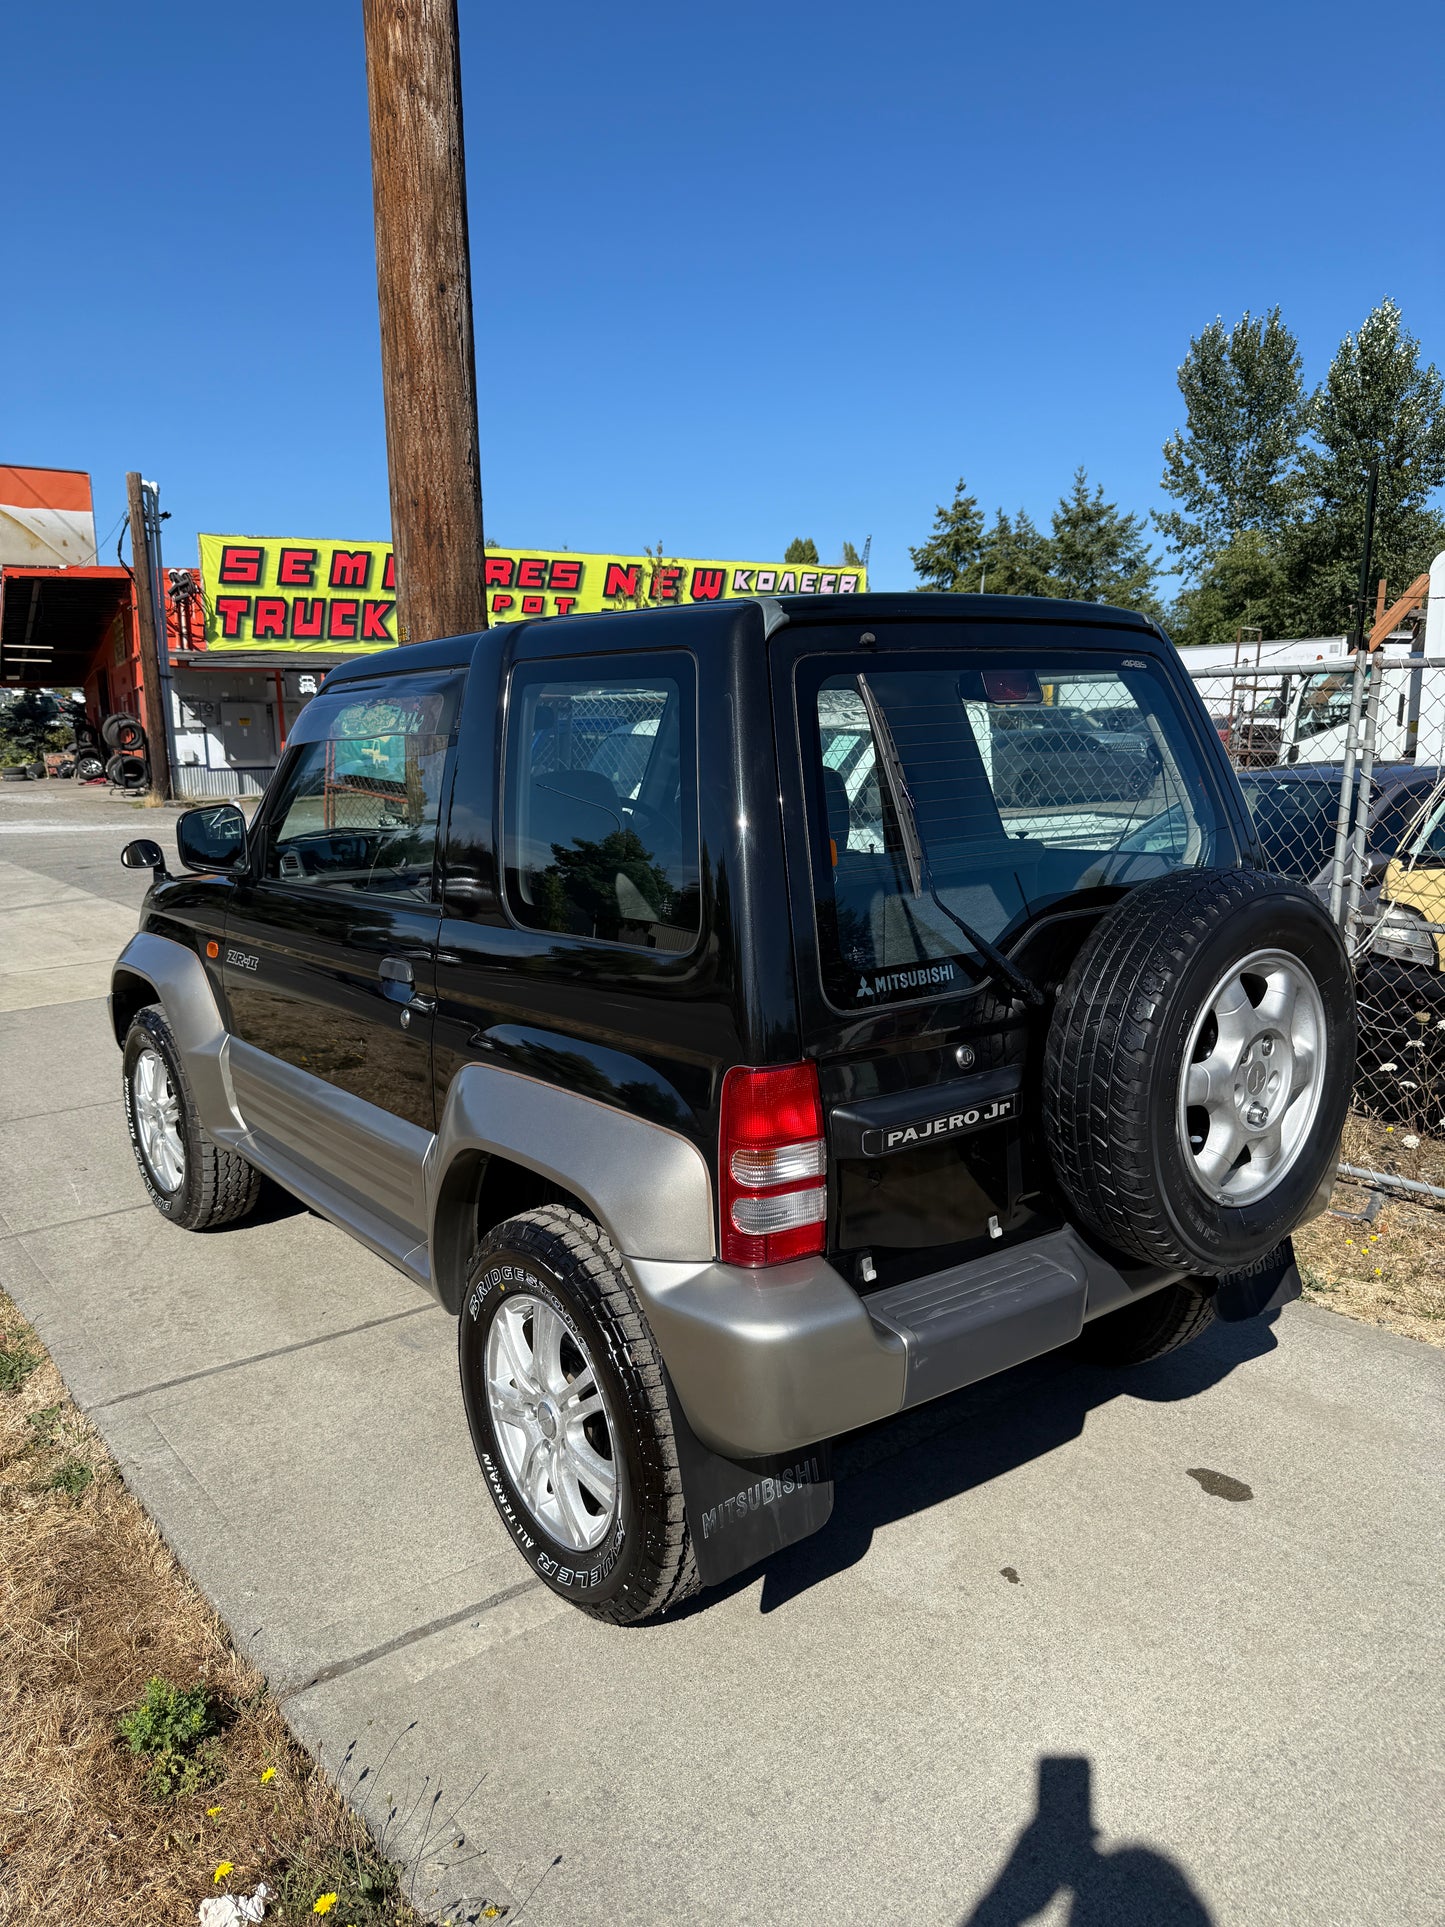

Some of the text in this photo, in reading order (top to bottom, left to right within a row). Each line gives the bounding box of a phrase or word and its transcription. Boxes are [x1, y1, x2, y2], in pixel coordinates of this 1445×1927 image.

[485, 556, 583, 591] RES
[602, 562, 727, 601] NEW
[215, 595, 396, 641] TRUCK
[491, 594, 576, 615] POT
[874, 964, 955, 993] MITSUBISHI
[887, 1100, 1012, 1147] PAJERO Jr
[701, 1457, 820, 1539] MITSUBISHI
